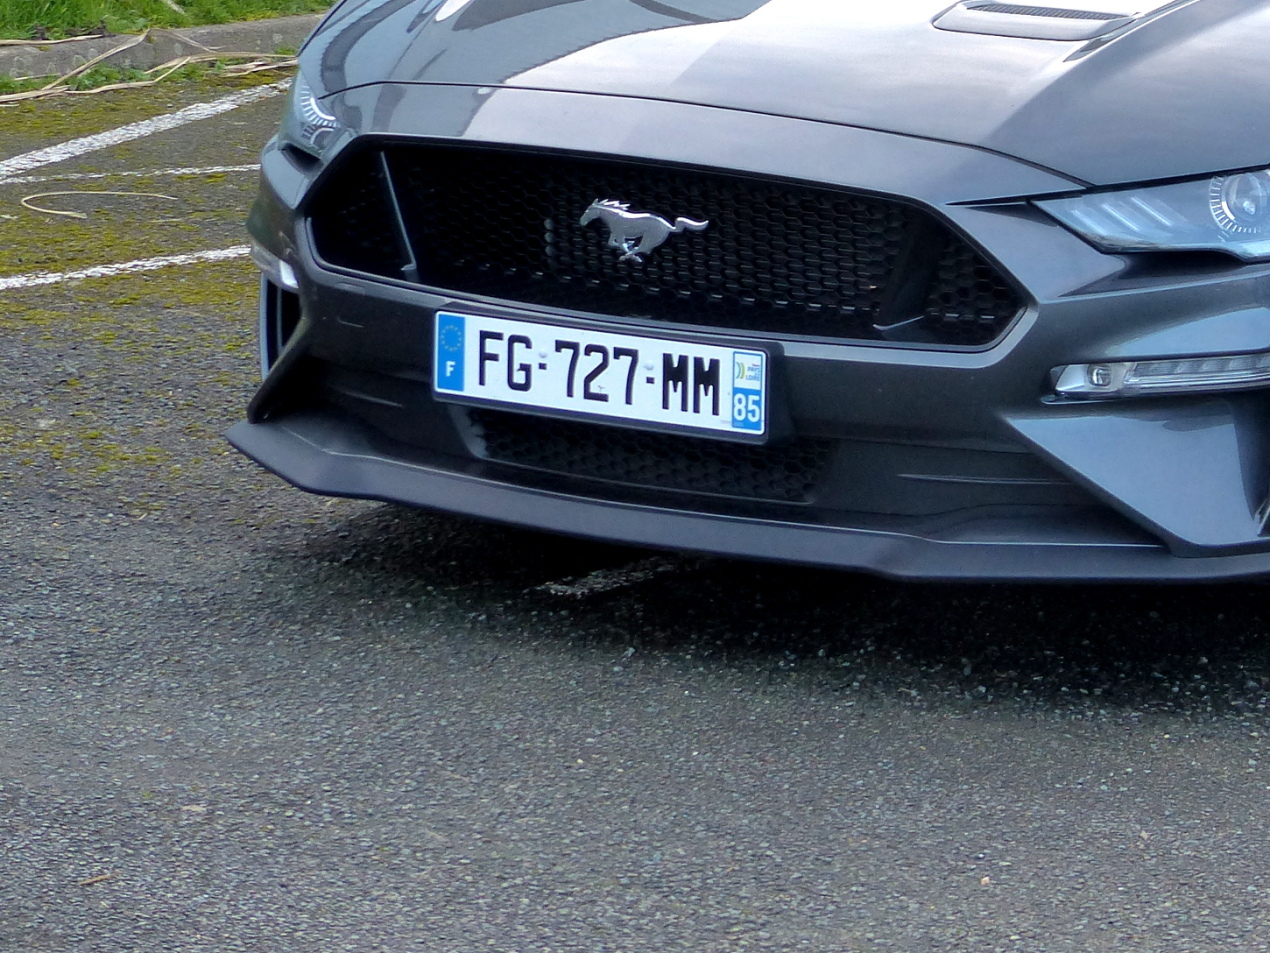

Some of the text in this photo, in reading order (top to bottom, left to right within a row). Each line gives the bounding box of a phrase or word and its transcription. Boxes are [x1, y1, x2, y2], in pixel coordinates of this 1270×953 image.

[446, 360, 456, 377] F
[478, 330, 721, 416] FG-727-MM
[733, 393, 760, 423] 85
